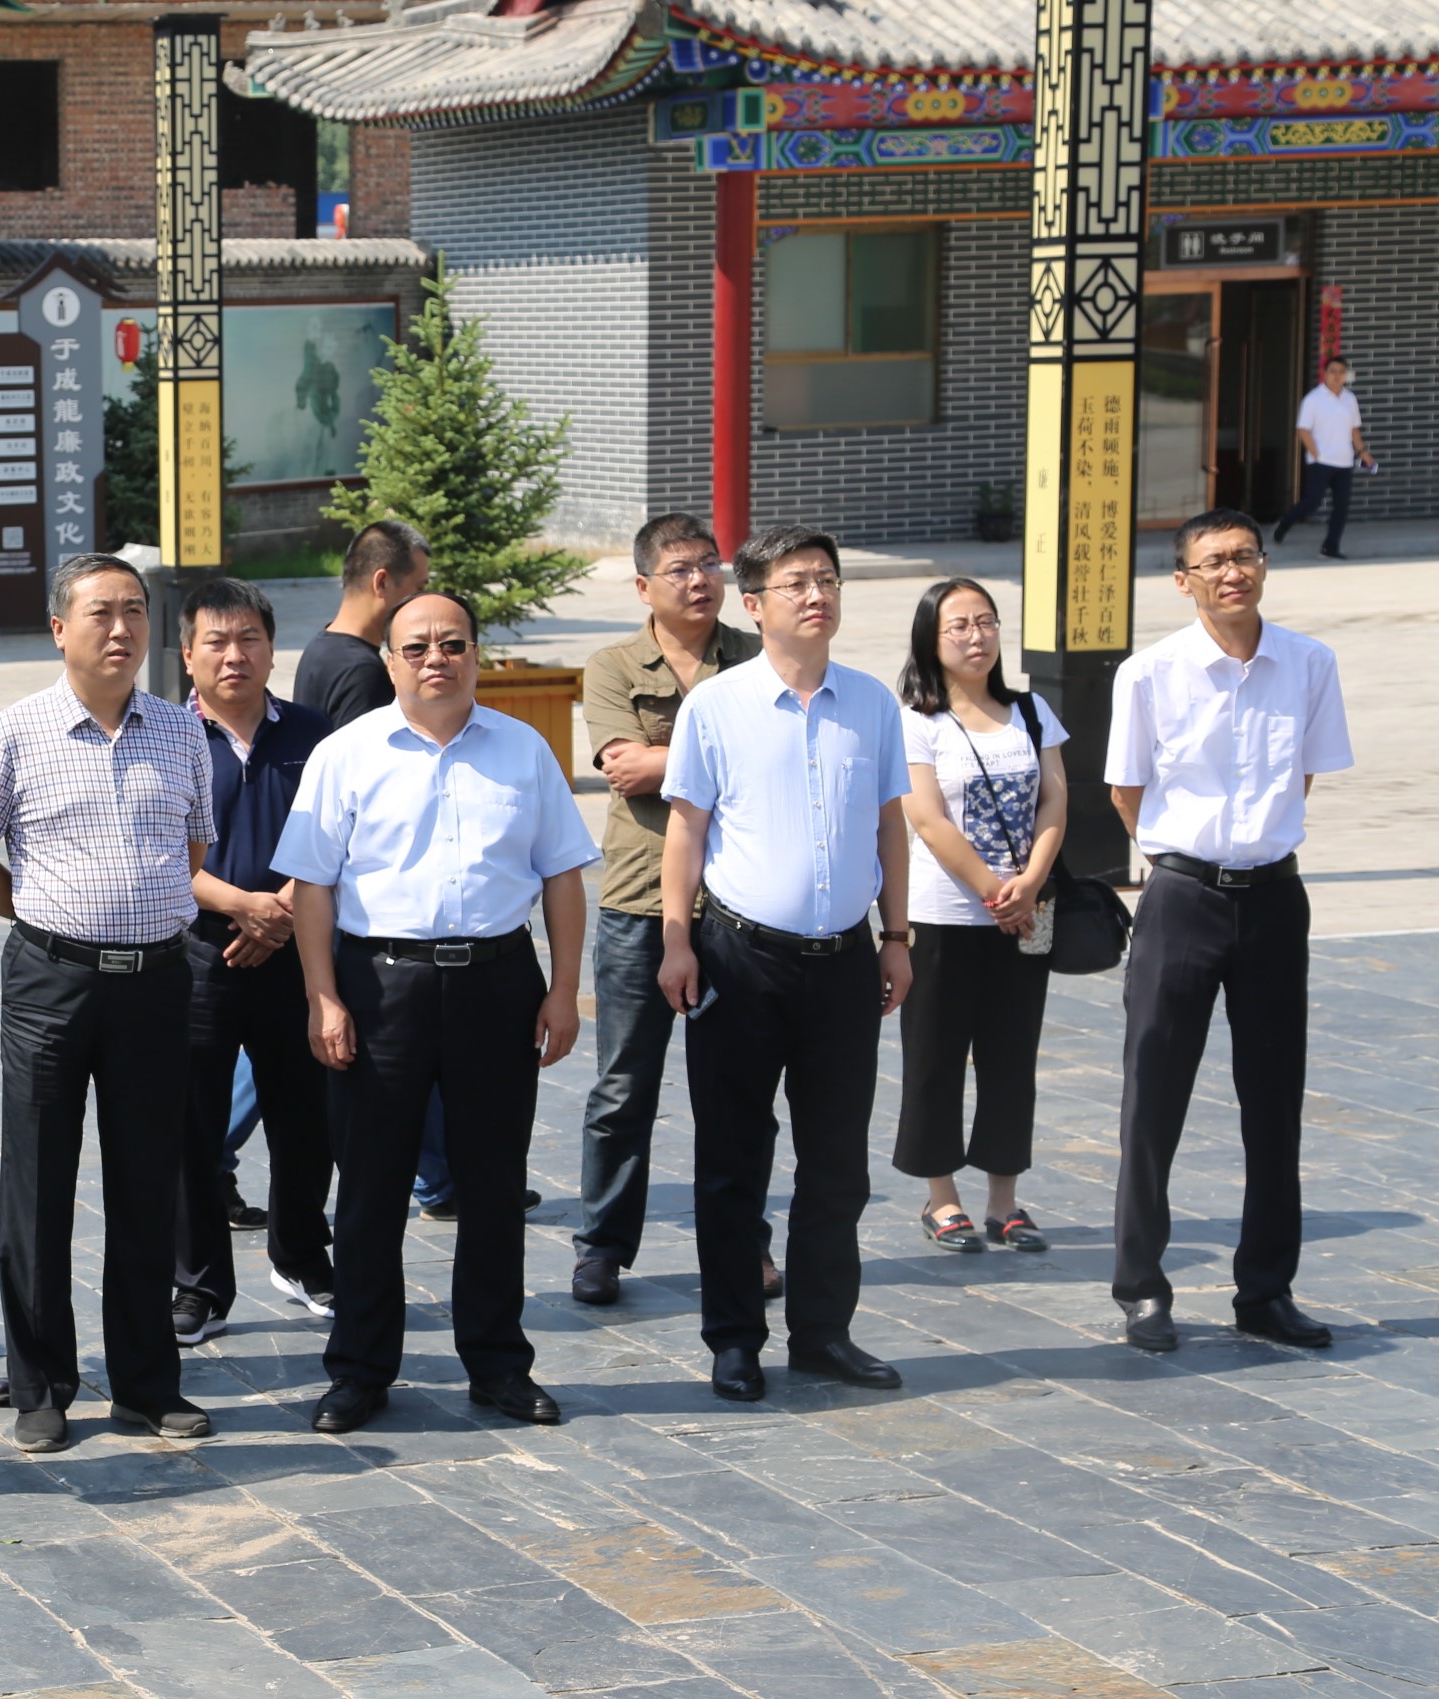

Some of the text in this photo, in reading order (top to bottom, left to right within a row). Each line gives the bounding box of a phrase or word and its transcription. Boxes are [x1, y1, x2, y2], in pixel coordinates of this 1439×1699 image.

[50, 338, 85, 567] 于成龍廉政文化
[960, 753, 990, 762] FALLNG
